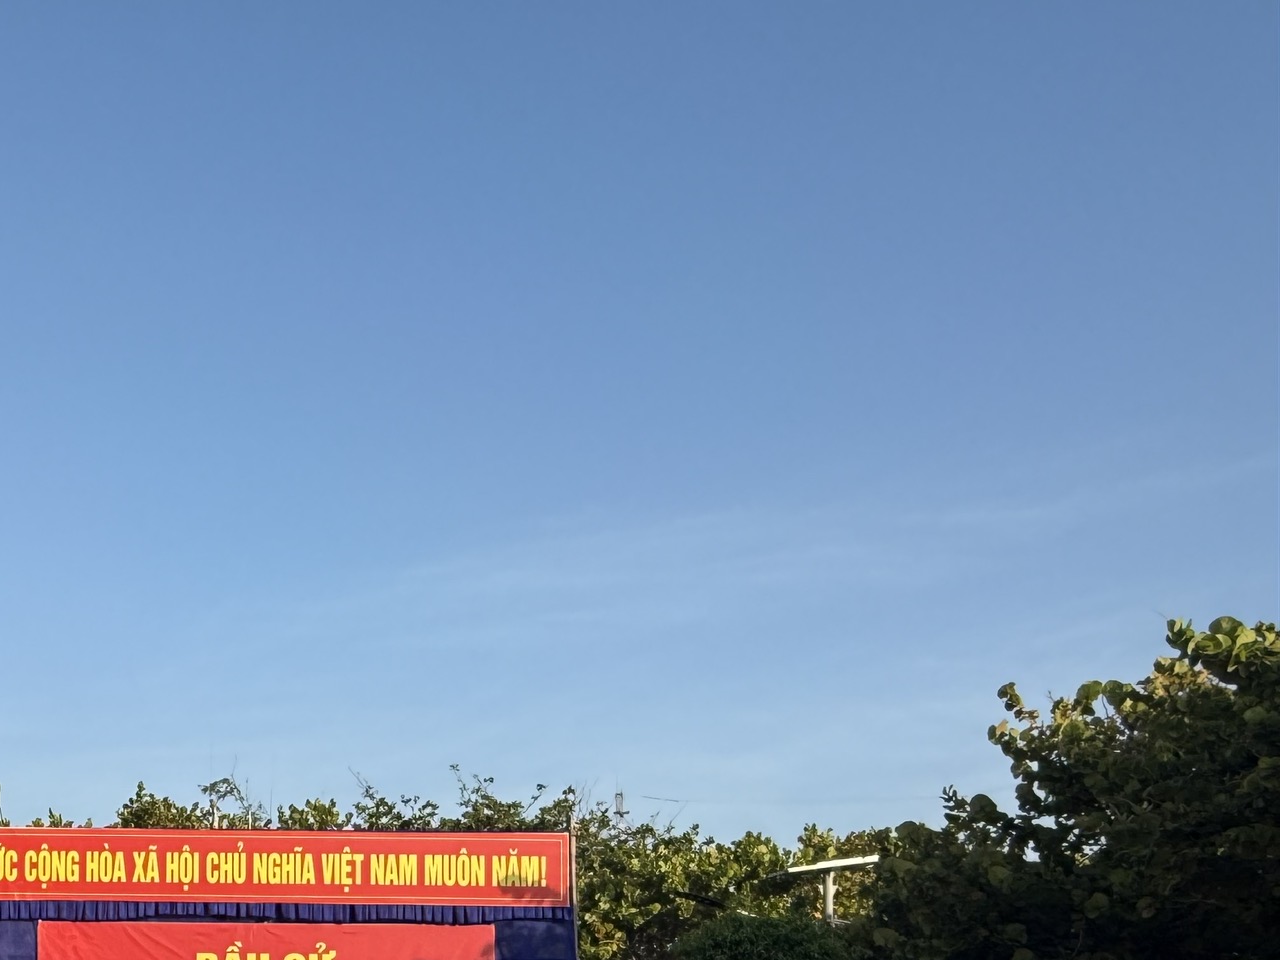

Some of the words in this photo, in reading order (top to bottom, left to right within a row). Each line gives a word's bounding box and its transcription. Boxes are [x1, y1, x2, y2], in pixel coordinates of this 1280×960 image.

[24, 843, 80, 889] CỘNG
[86, 843, 126, 883] HÒA
[132, 845, 160, 883] XÃ
[166, 845, 199, 891] HỘI
[206, 841, 246, 884] CHỦ
[253, 846, 315, 885] NGHĨA
[321, 846, 364, 892] VIỆT
[370, 854, 418, 886] NAM
[424, 848, 485, 887] MUÔN
[492, 848, 547, 888] NĂM!
